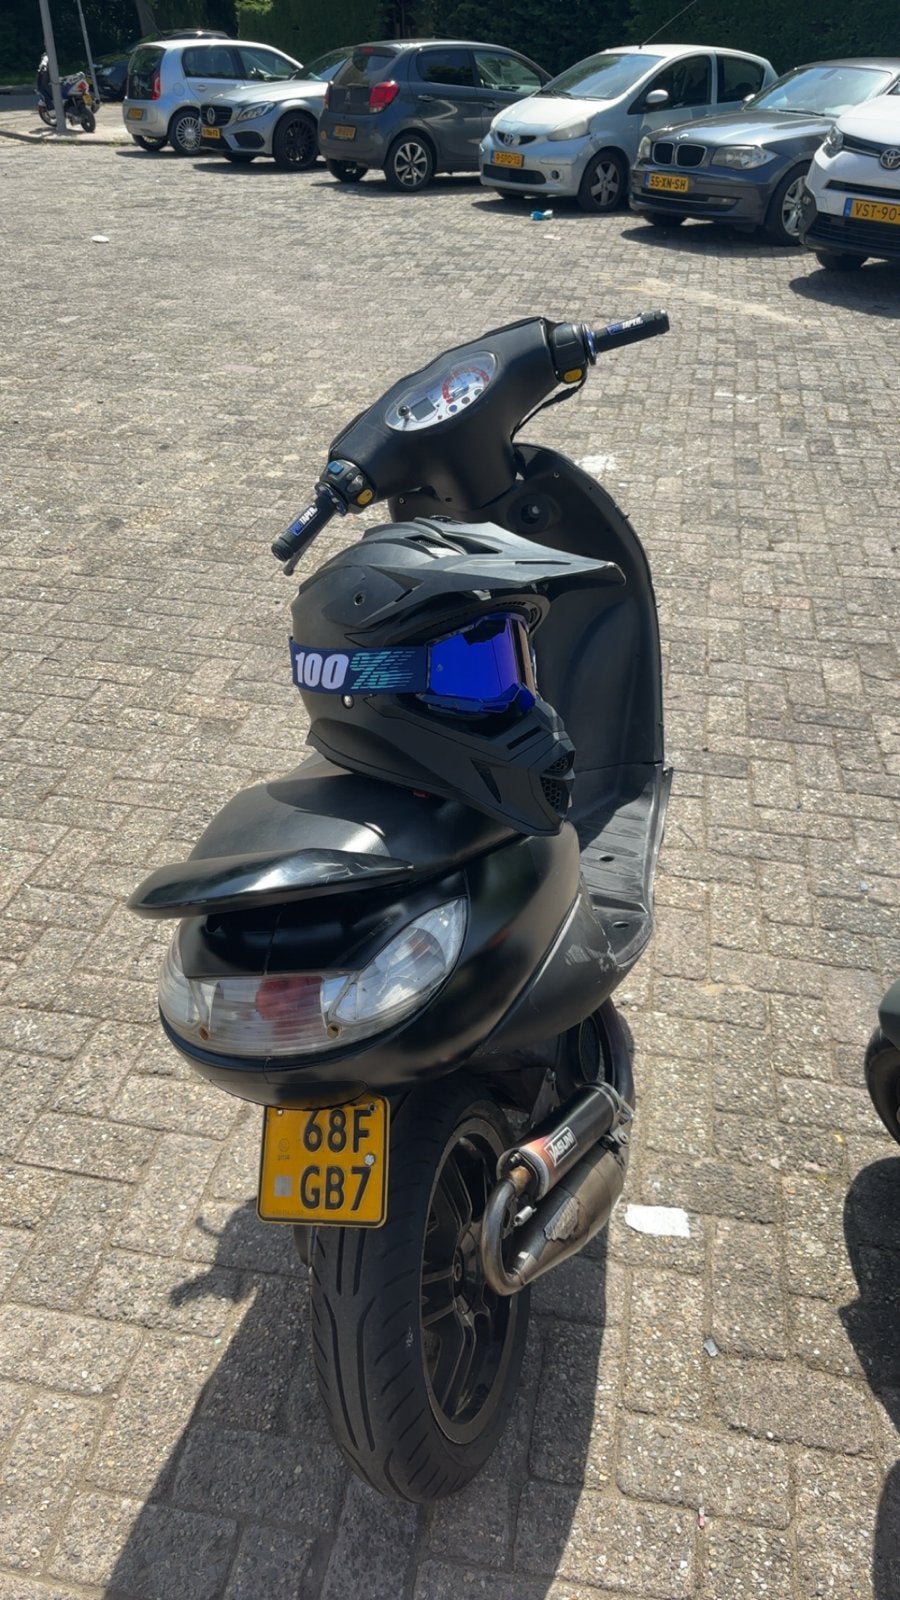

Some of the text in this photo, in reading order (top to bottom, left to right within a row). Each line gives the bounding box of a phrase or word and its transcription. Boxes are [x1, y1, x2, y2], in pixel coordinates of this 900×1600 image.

[650, 175, 687, 190] 55-XN-SH
[295, 650, 412, 690] 100%
[303, 1109, 373, 1153] 68F
[549, 1130, 577, 1165] YASUNI
[300, 1165, 371, 1211] GB7
